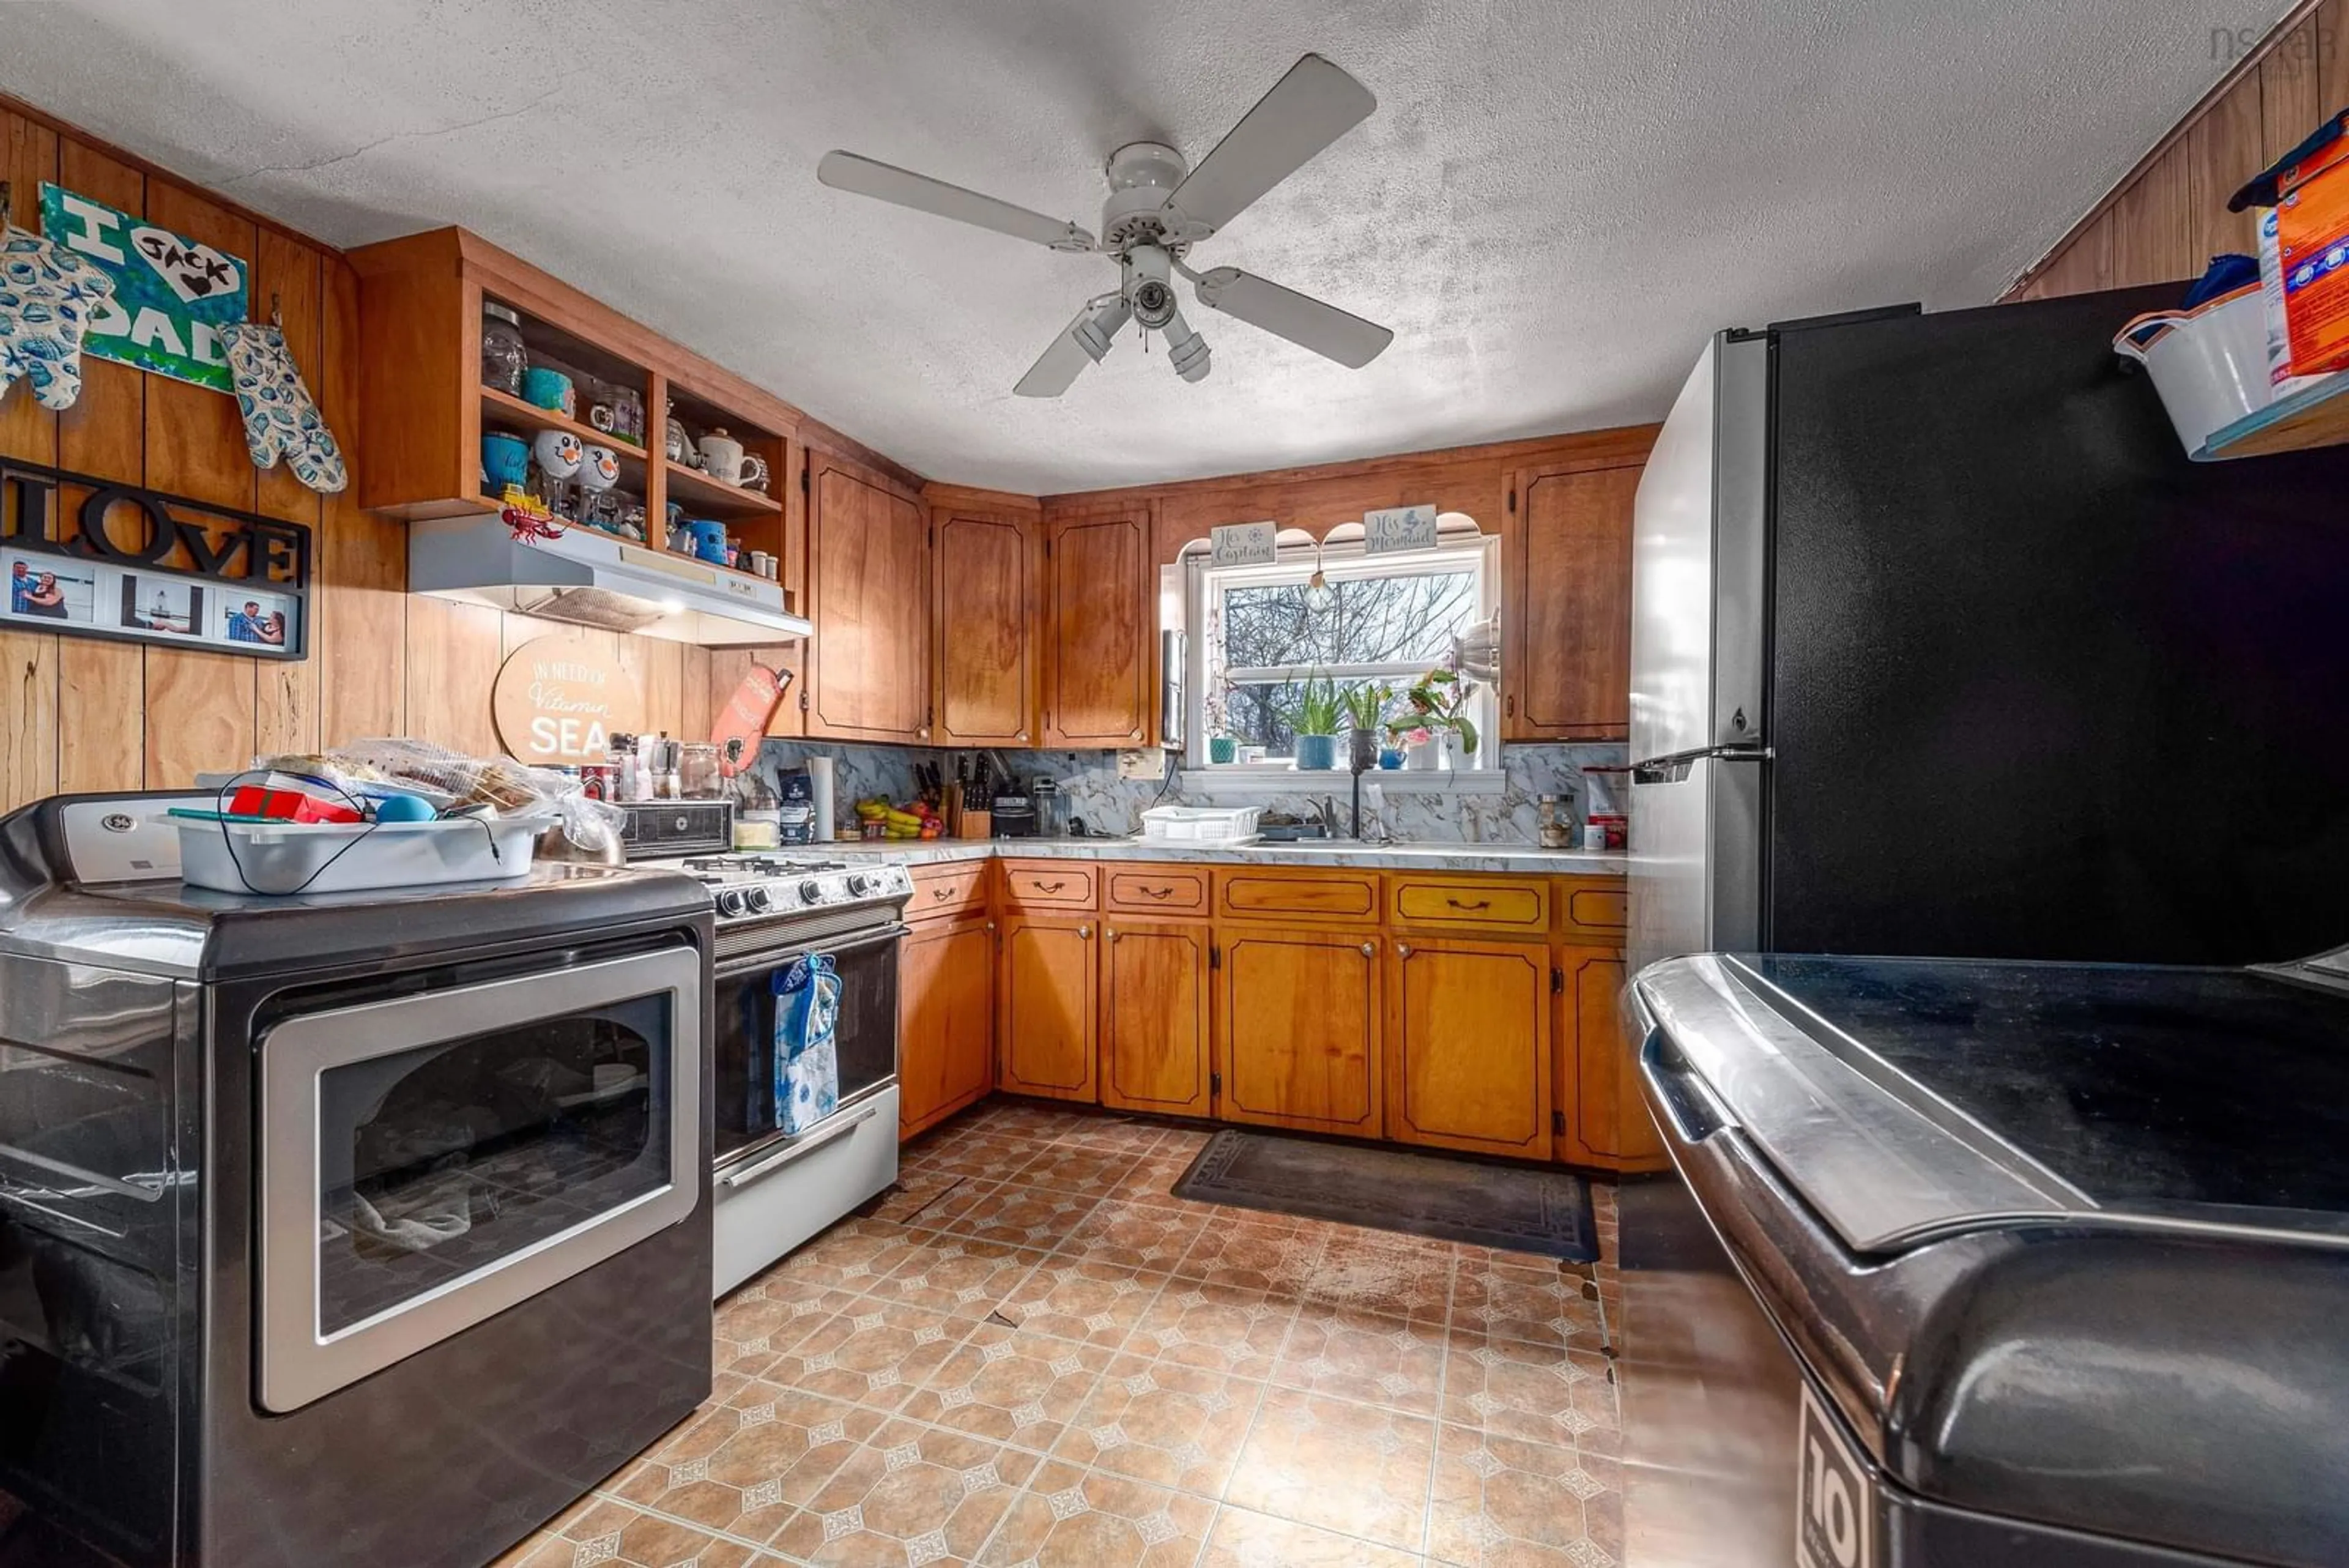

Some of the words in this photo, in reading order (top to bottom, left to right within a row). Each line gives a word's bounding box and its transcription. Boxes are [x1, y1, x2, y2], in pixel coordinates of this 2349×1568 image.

[63, 194, 125, 265] I
[138, 236, 229, 286] JACK
[5, 475, 298, 583] LOVE
[552, 661, 588, 683] NEED
[529, 680, 613, 719] Vitamin
[529, 715, 610, 757] SEA
[1809, 1433, 1857, 1568] 10
